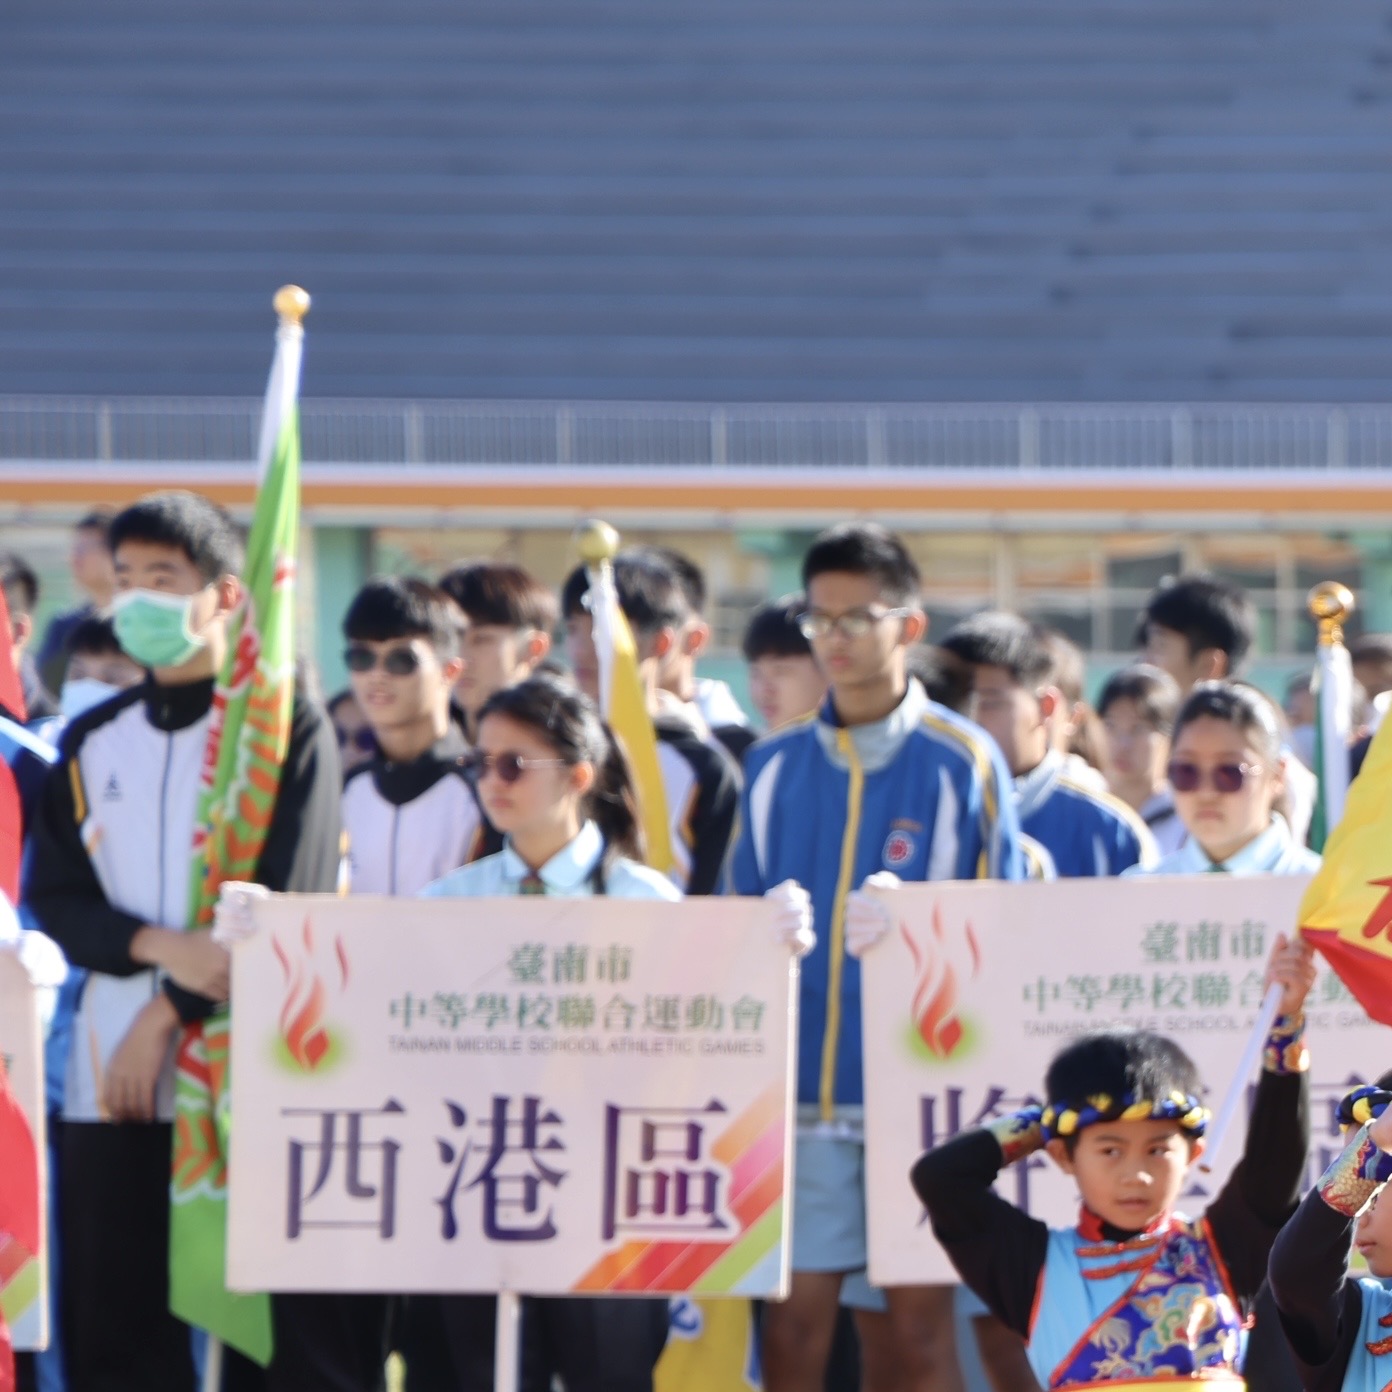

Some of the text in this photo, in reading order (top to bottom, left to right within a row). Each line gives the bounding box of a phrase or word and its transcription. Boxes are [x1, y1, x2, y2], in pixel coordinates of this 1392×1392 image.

[1142, 919, 1267, 963] 臺南市
[507, 943, 634, 984] 臺南市
[389, 992, 766, 1032] 中等學校聯合運動會
[389, 1035, 764, 1055] TAINAN MIDDLE SCHOOL ATHLETIC GAMES
[281, 1093, 728, 1243] 西港區
